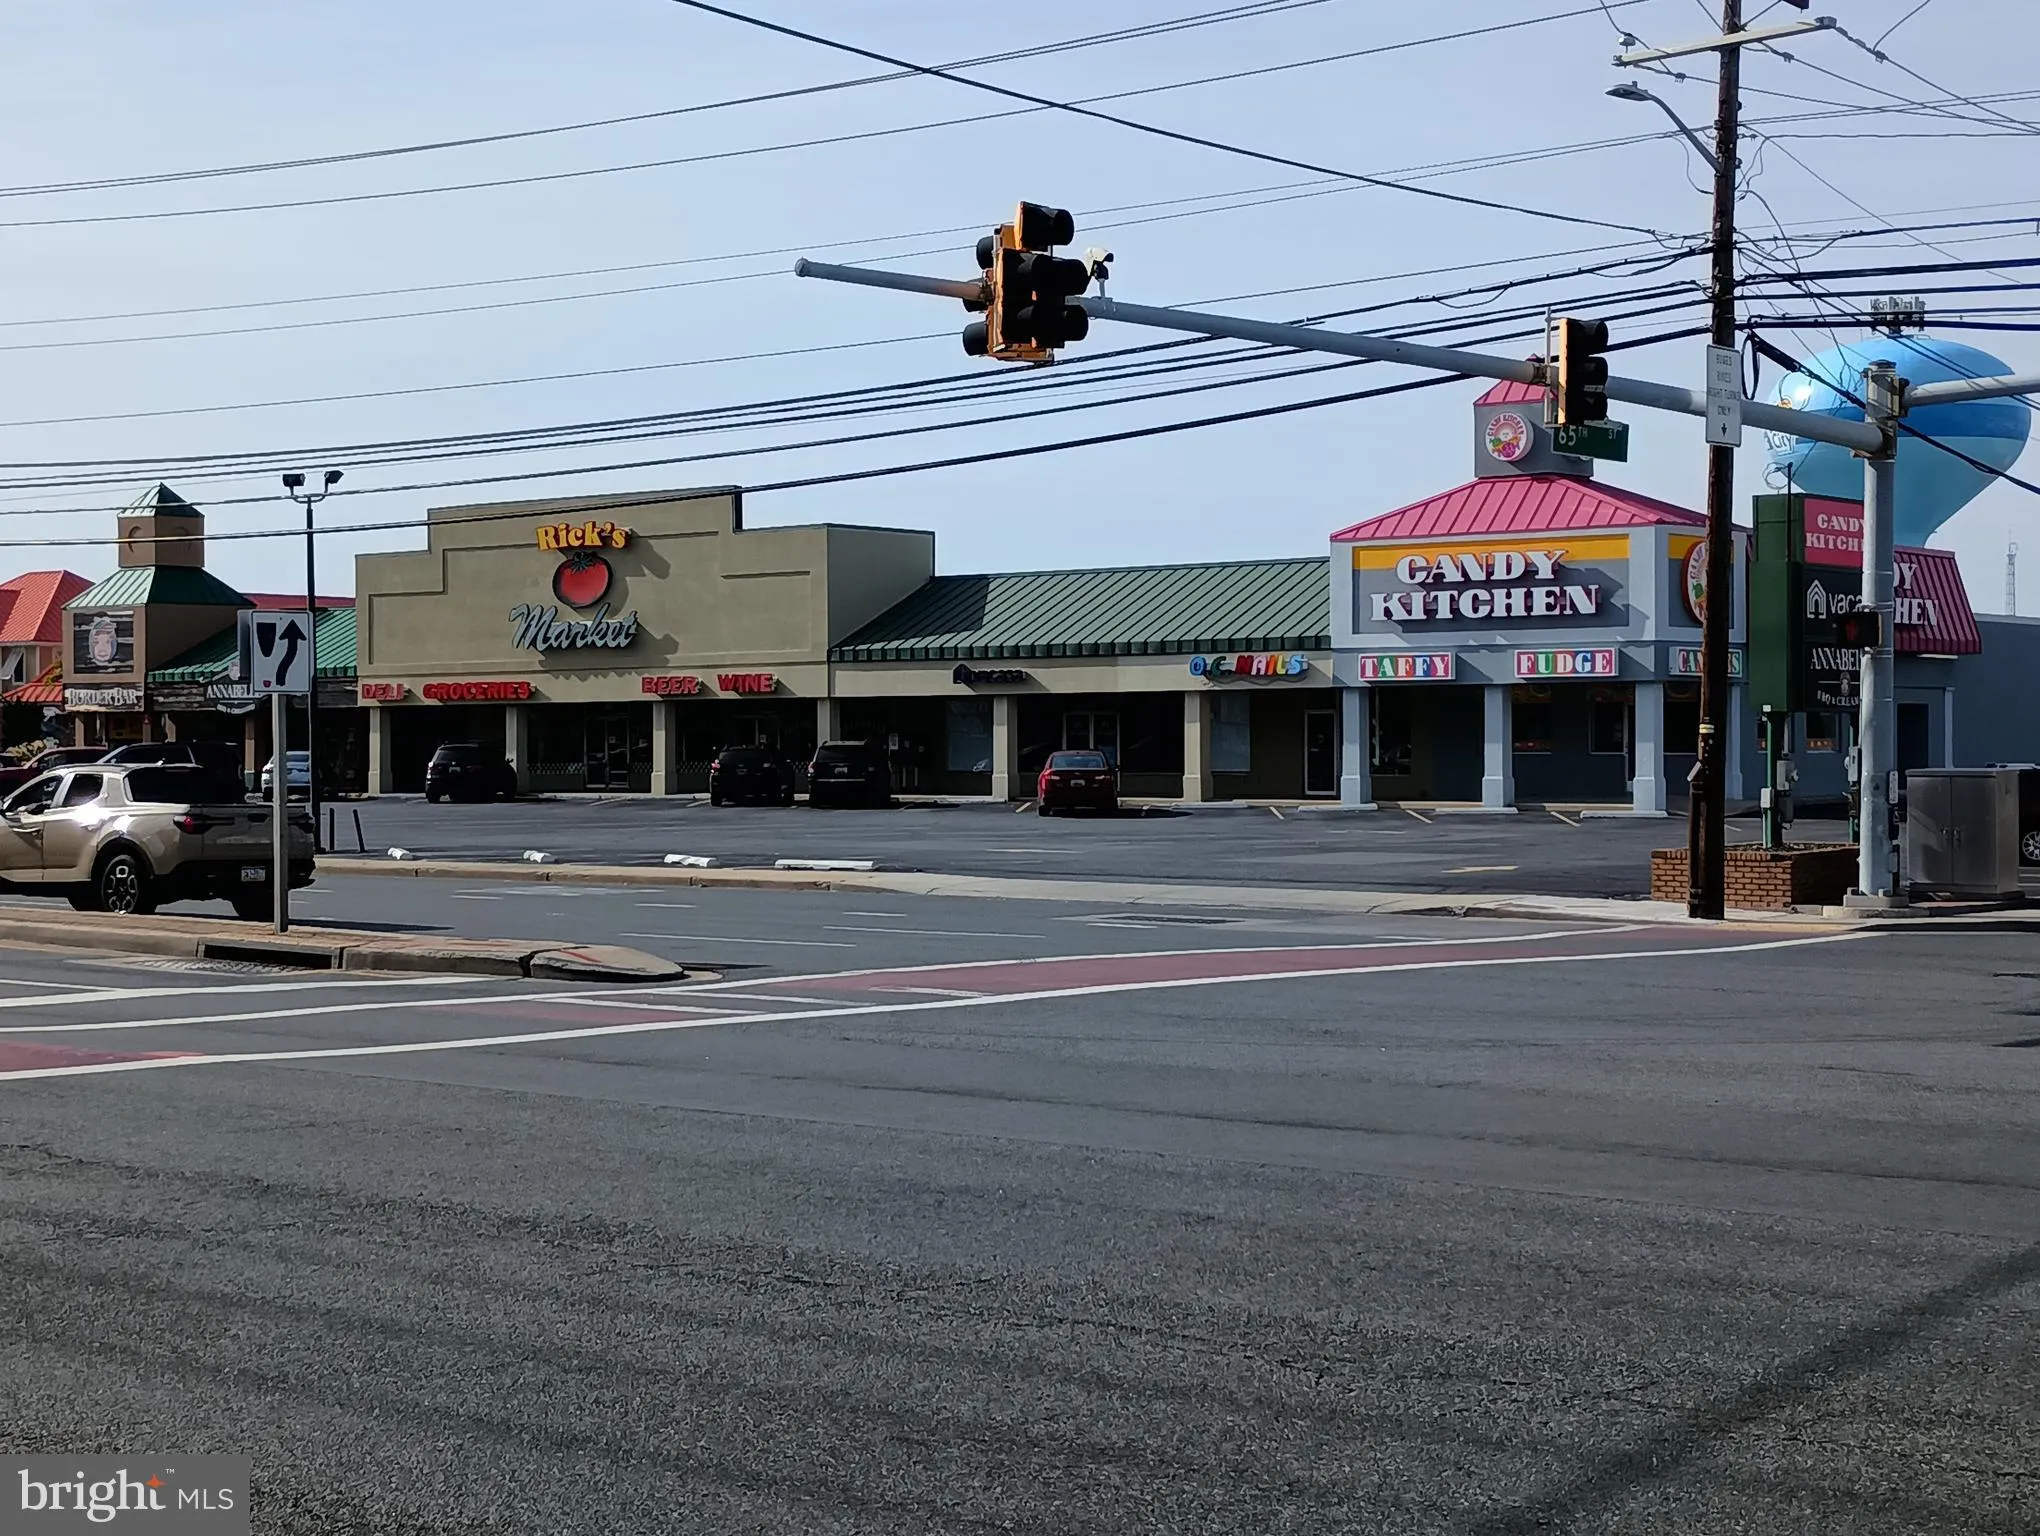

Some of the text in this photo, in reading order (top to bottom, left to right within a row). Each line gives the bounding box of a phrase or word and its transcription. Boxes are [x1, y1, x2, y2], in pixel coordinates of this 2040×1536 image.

[1608, 429, 1618, 440] ST
[537, 520, 627, 551] Rick's
[1805, 532, 1864, 552] KITCH
[1396, 549, 1568, 585] CANDY
[1370, 584, 1600, 622] KITCHEN
[509, 602, 638, 652] Market
[1235, 654, 1305, 676] NAILS
[1361, 655, 1450, 679] TAFFY
[1519, 651, 1613, 674] FUDGE
[362, 684, 405, 700] DELI
[423, 681, 535, 700] GROCERIES
[641, 675, 699, 695] BEER
[717, 673, 775, 694] WINE
[114, 688, 137, 706] BAR
